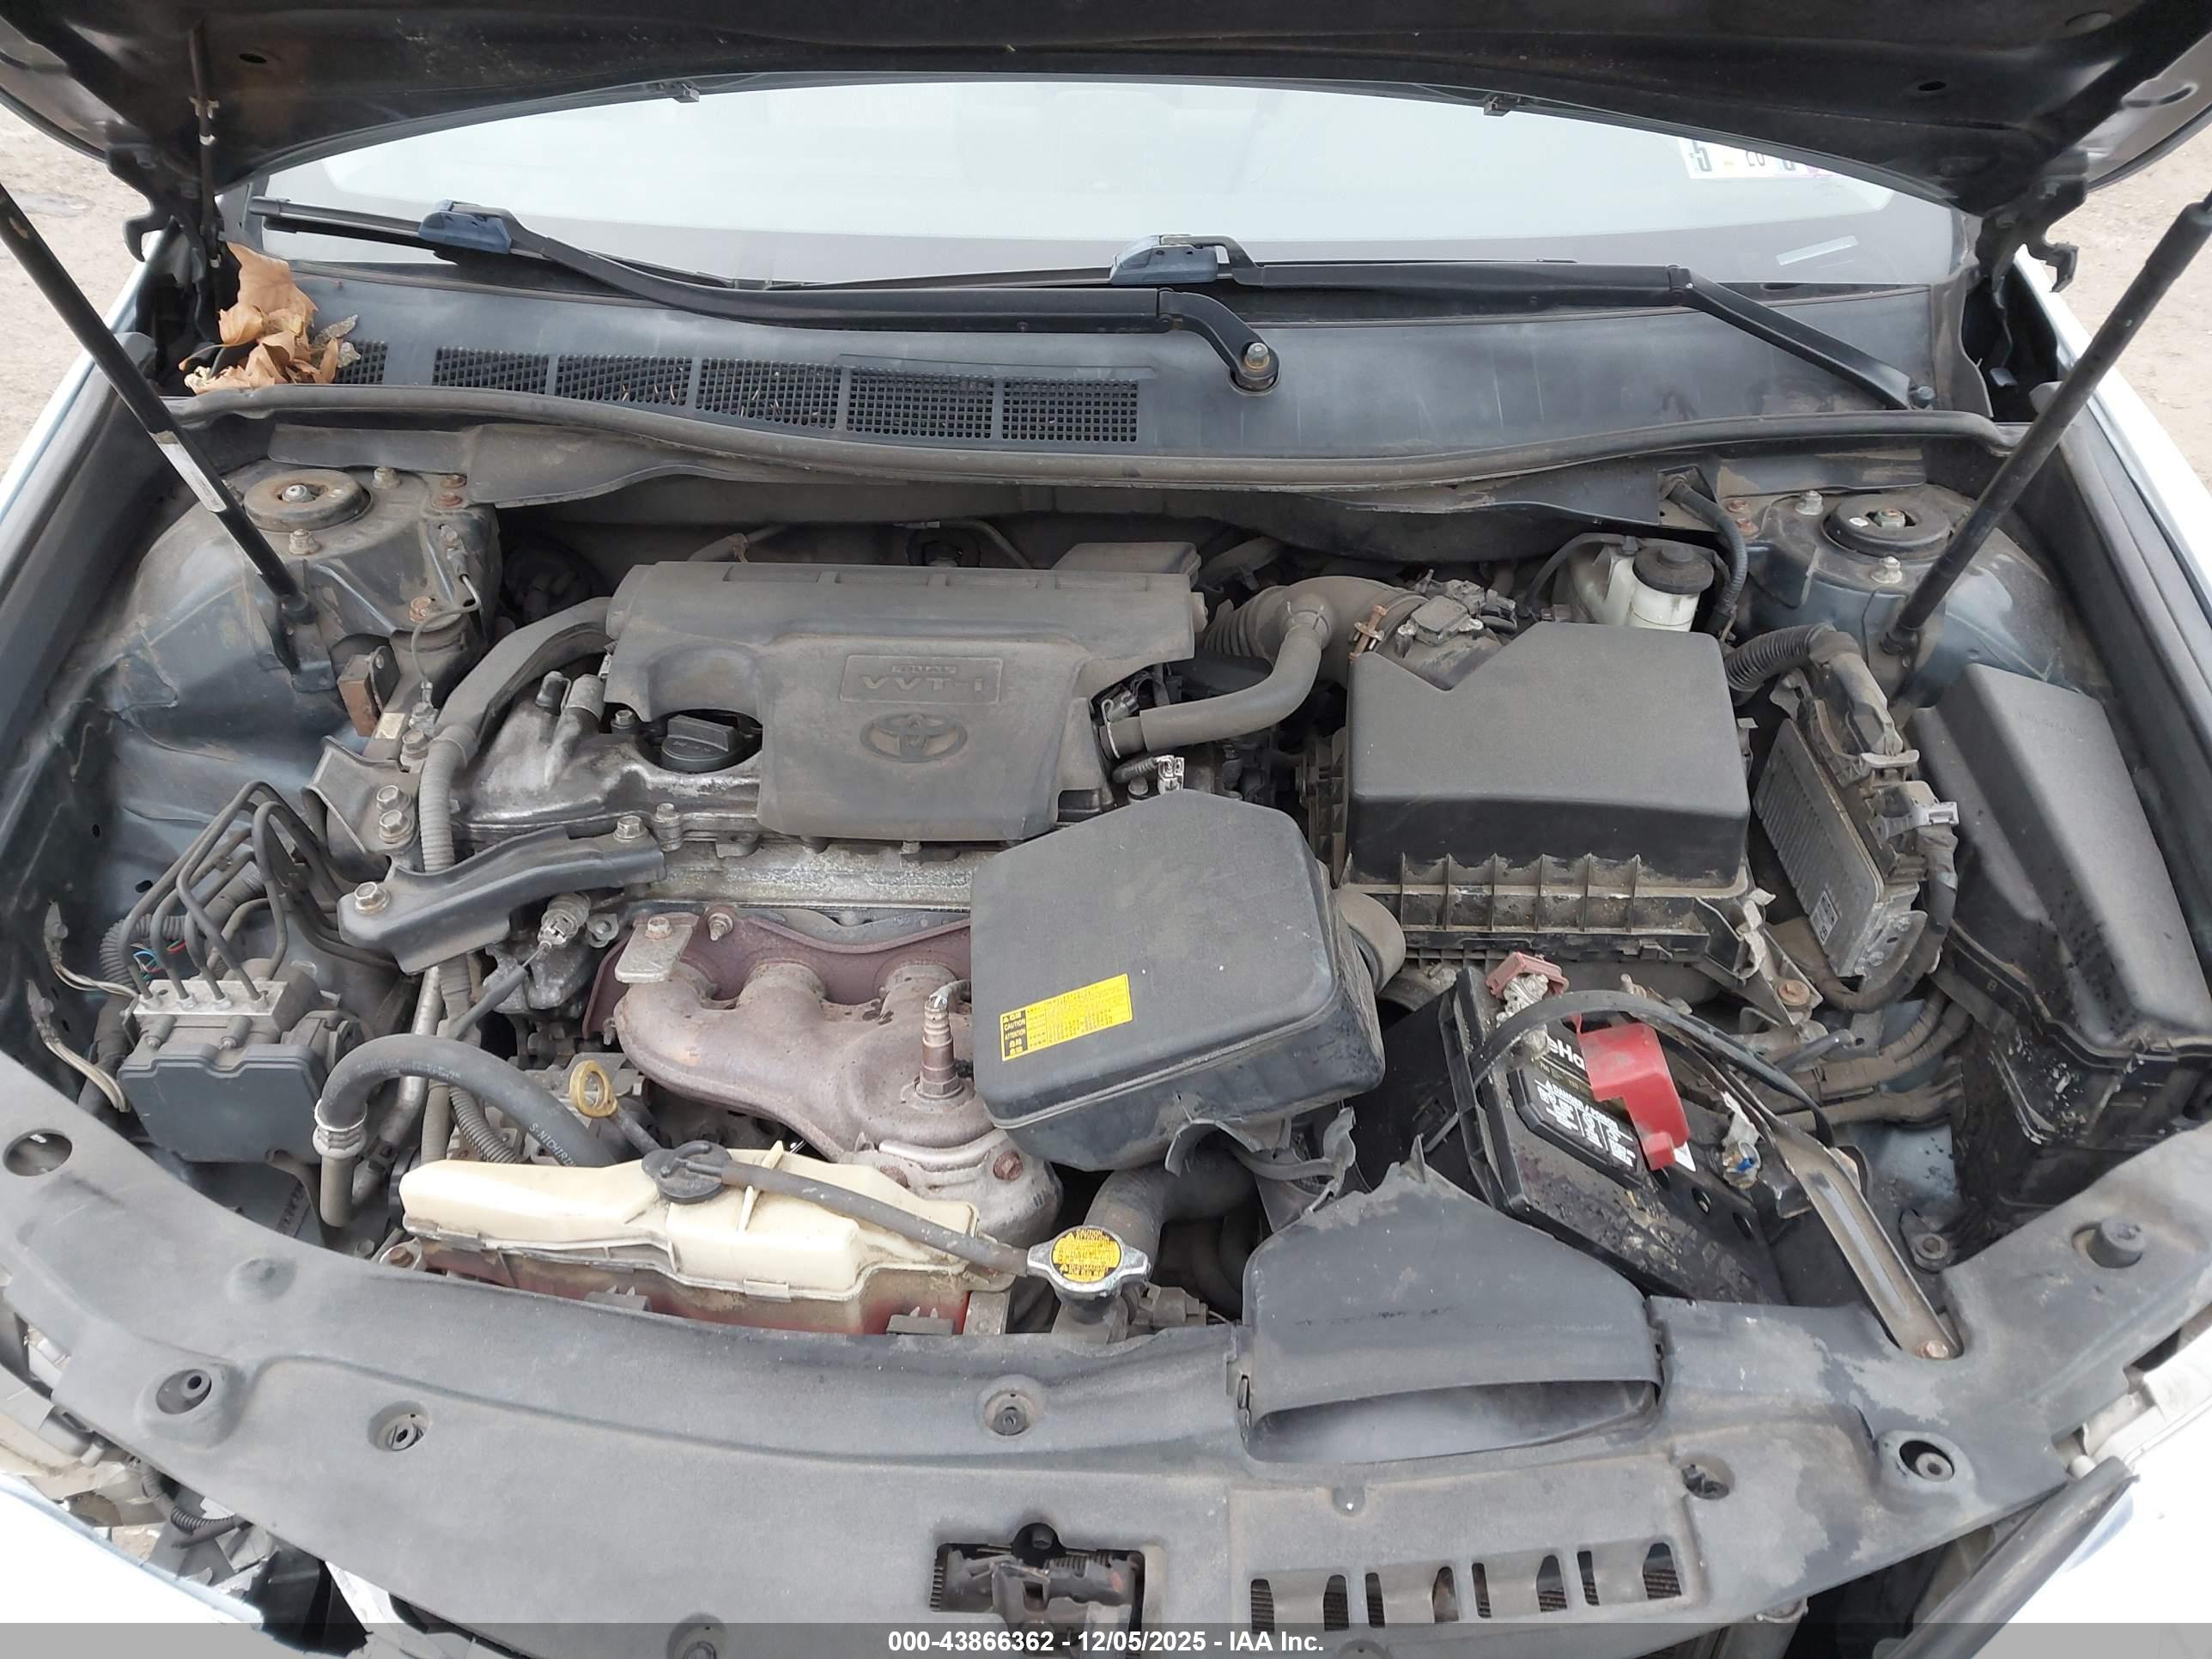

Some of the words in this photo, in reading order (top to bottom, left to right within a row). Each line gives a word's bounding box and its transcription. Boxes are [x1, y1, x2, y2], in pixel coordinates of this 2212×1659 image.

[1004, 1018, 1026, 1030] CAUTION
[1547, 1036, 1586, 1071] eHa
[1552, 1084, 1584, 1109] DANGER
